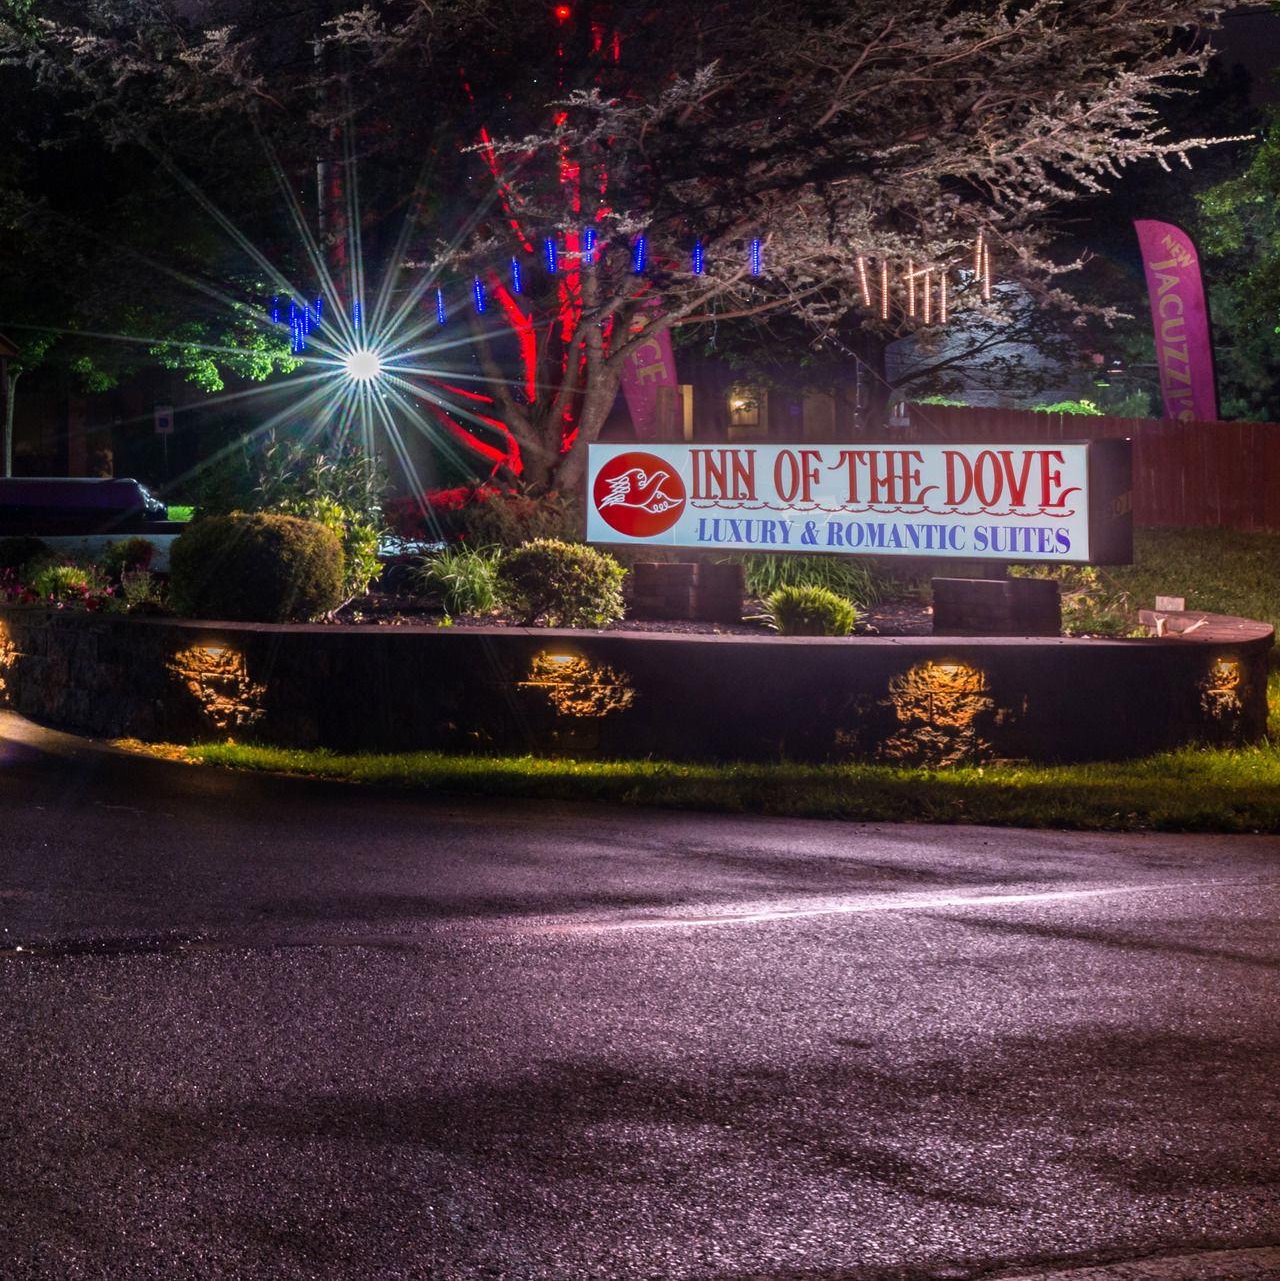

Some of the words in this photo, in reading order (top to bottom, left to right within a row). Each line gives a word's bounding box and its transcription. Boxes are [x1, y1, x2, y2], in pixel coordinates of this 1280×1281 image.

[1161, 234, 1195, 268] NEW
[689, 449, 758, 501] INN
[774, 449, 823, 503] OF
[827, 450, 940, 505] THE
[942, 450, 1082, 507] DOVE
[697, 518, 794, 545] LUXURY
[801, 521, 820, 546] &
[826, 521, 966, 551] ROMANTIC
[973, 525, 1071, 555] SUITES
